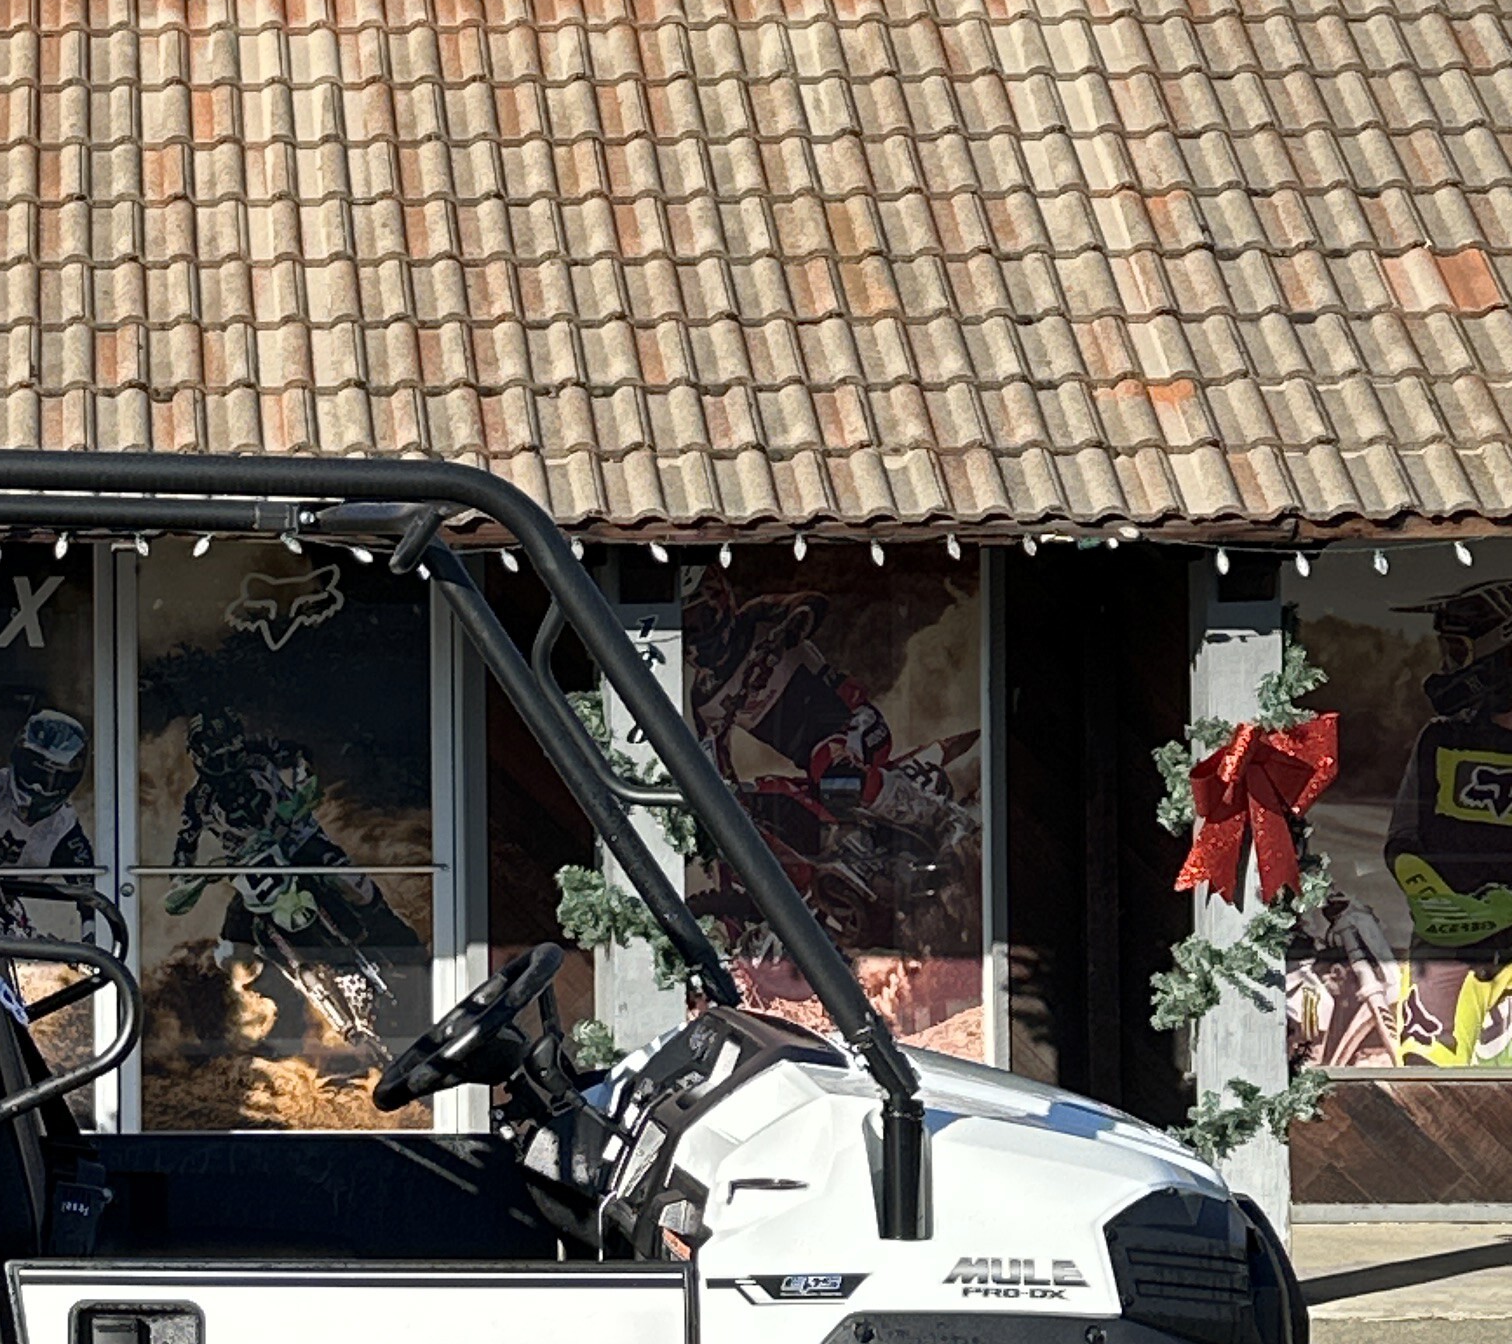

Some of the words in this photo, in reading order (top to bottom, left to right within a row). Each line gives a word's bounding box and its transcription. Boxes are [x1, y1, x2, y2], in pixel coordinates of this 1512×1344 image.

[1405, 873, 1438, 902] FO
[942, 1257, 1091, 1287] MULE
[962, 1287, 1070, 1301] PRO-DX
